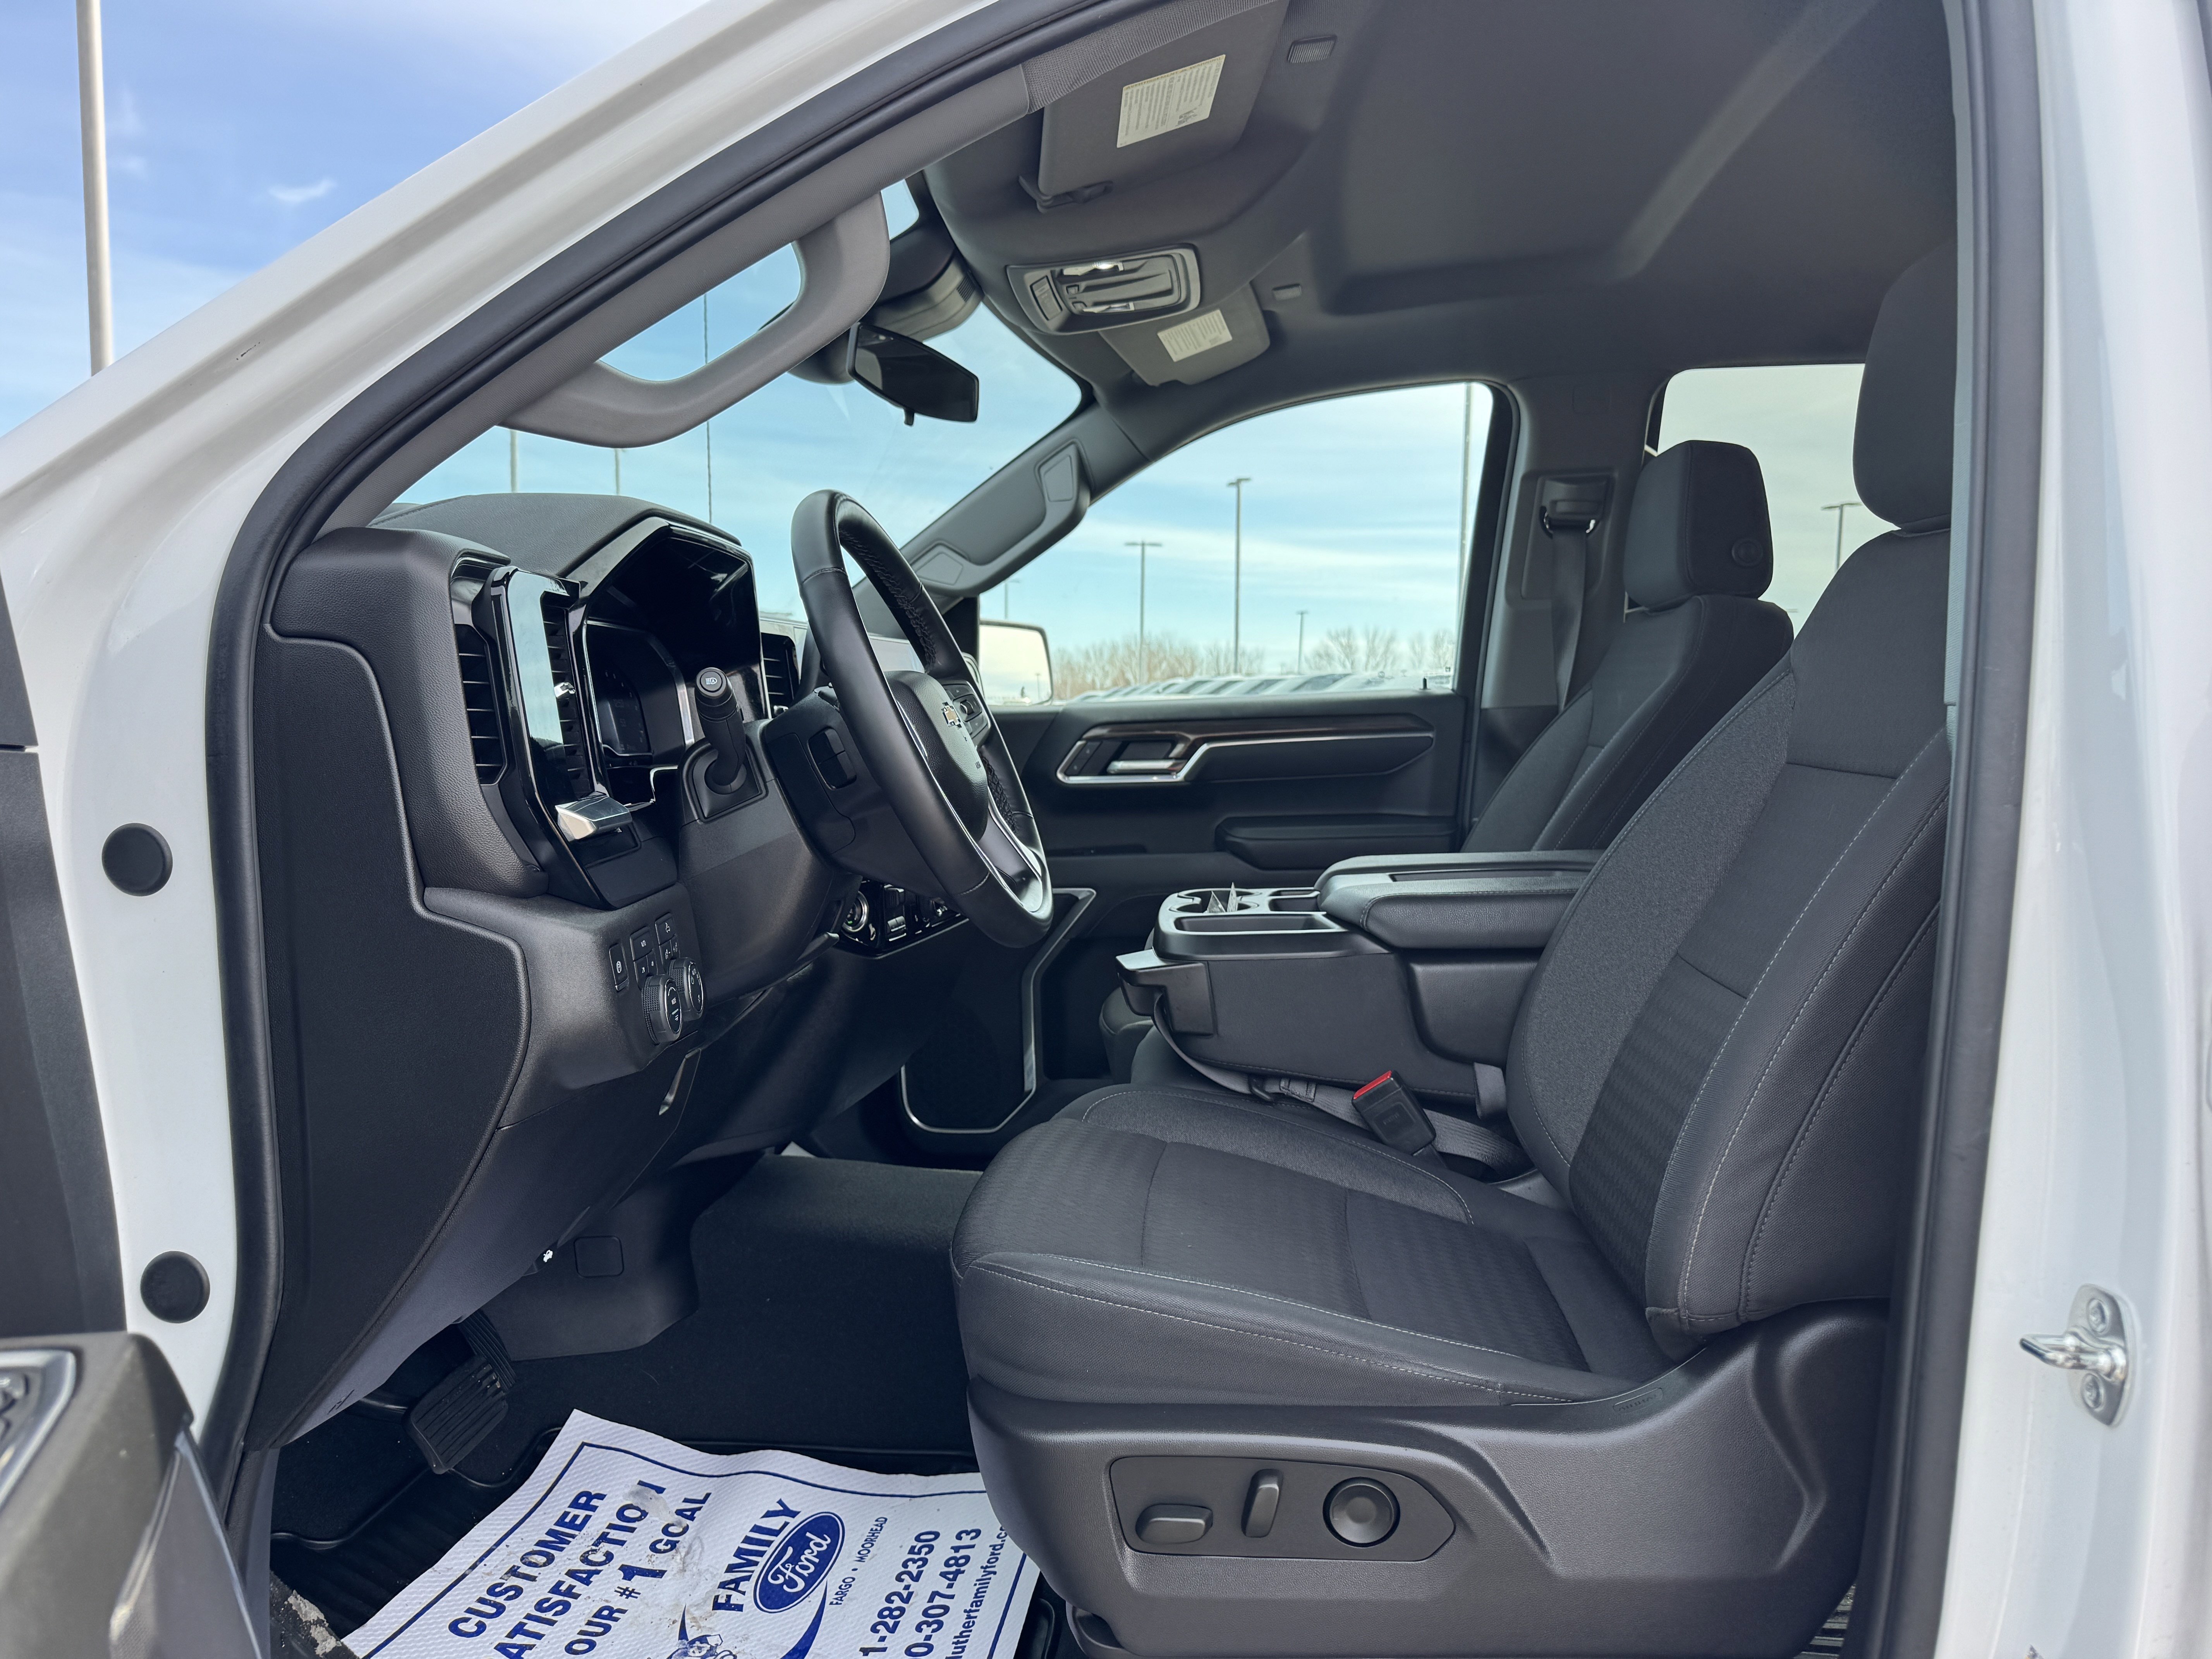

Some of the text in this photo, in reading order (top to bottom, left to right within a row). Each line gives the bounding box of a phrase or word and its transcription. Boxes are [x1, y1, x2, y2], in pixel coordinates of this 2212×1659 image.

[448, 1490, 608, 1638] CUSTOMER
[564, 1605, 629, 1655] OUR
[649, 1492, 712, 1554] GOAL
[711, 1498, 802, 1613] FAMILY
[767, 1532, 831, 1592] Ford
[829, 1516, 888, 1606] FARGO MOORHEAD
[858, 1530, 941, 1657] 1-282-2350
